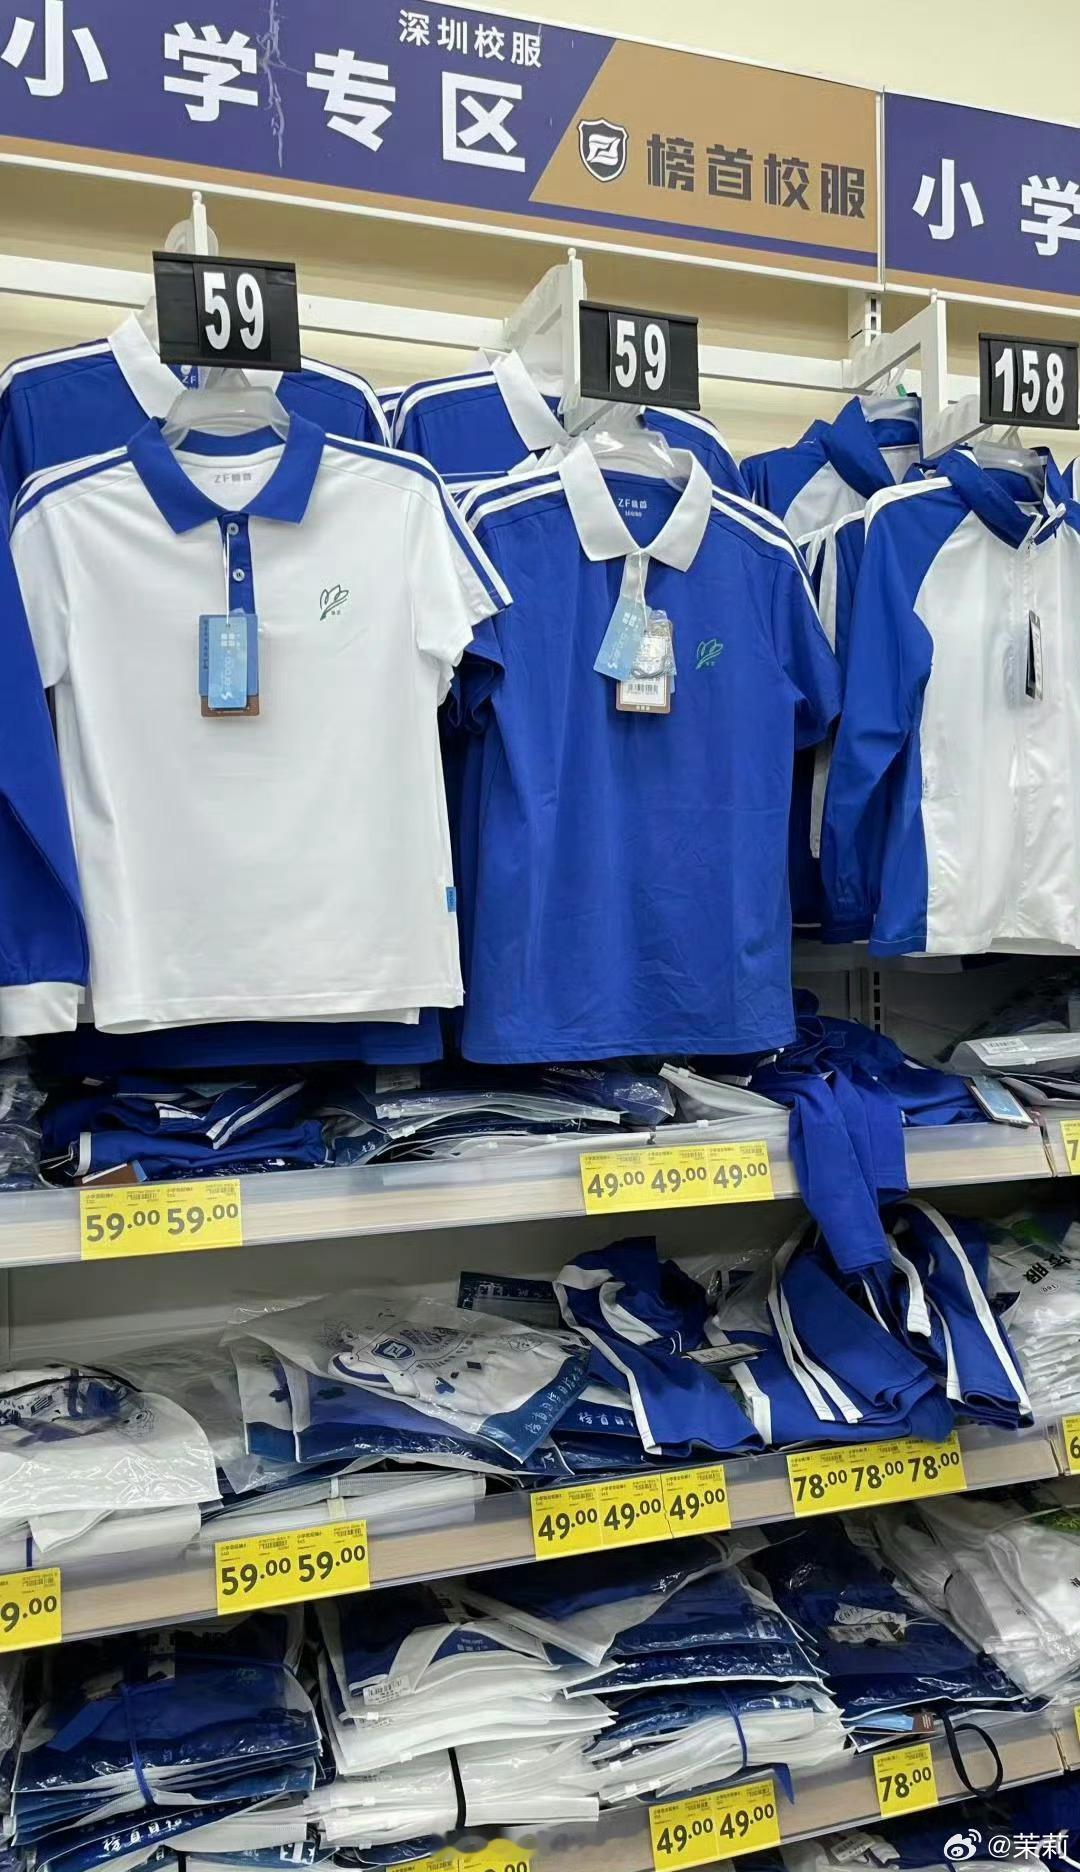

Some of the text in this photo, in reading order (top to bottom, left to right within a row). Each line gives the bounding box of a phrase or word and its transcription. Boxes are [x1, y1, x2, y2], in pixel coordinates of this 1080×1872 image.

[398, 9, 543, 68] 深圳校服
[0, 0, 526, 173] 小学专区
[646, 133, 866, 220] 榜首校服
[911, 158, 1080, 257] 小学
[202, 272, 265, 351] 59
[615, 319, 668, 391] 59
[994, 347, 1065, 416] 158
[587, 1162, 768, 1199] 49.00 49.00 49.00
[86, 1203, 239, 1242] 59.00 59.00
[793, 1469, 848, 1502] 78.00
[851, 1460, 904, 1492] 78.00
[908, 1451, 960, 1483] 78.00
[538, 1508, 598, 1541] 49.00
[604, 1498, 662, 1531] 49.00
[669, 1488, 725, 1520] 49.00
[221, 1557, 291, 1596] 59.00
[298, 1545, 366, 1583] 59.00
[879, 1766, 932, 1803] 78.00
[656, 1818, 714, 1854] 49.00
[720, 1803, 775, 1840] 49.00
